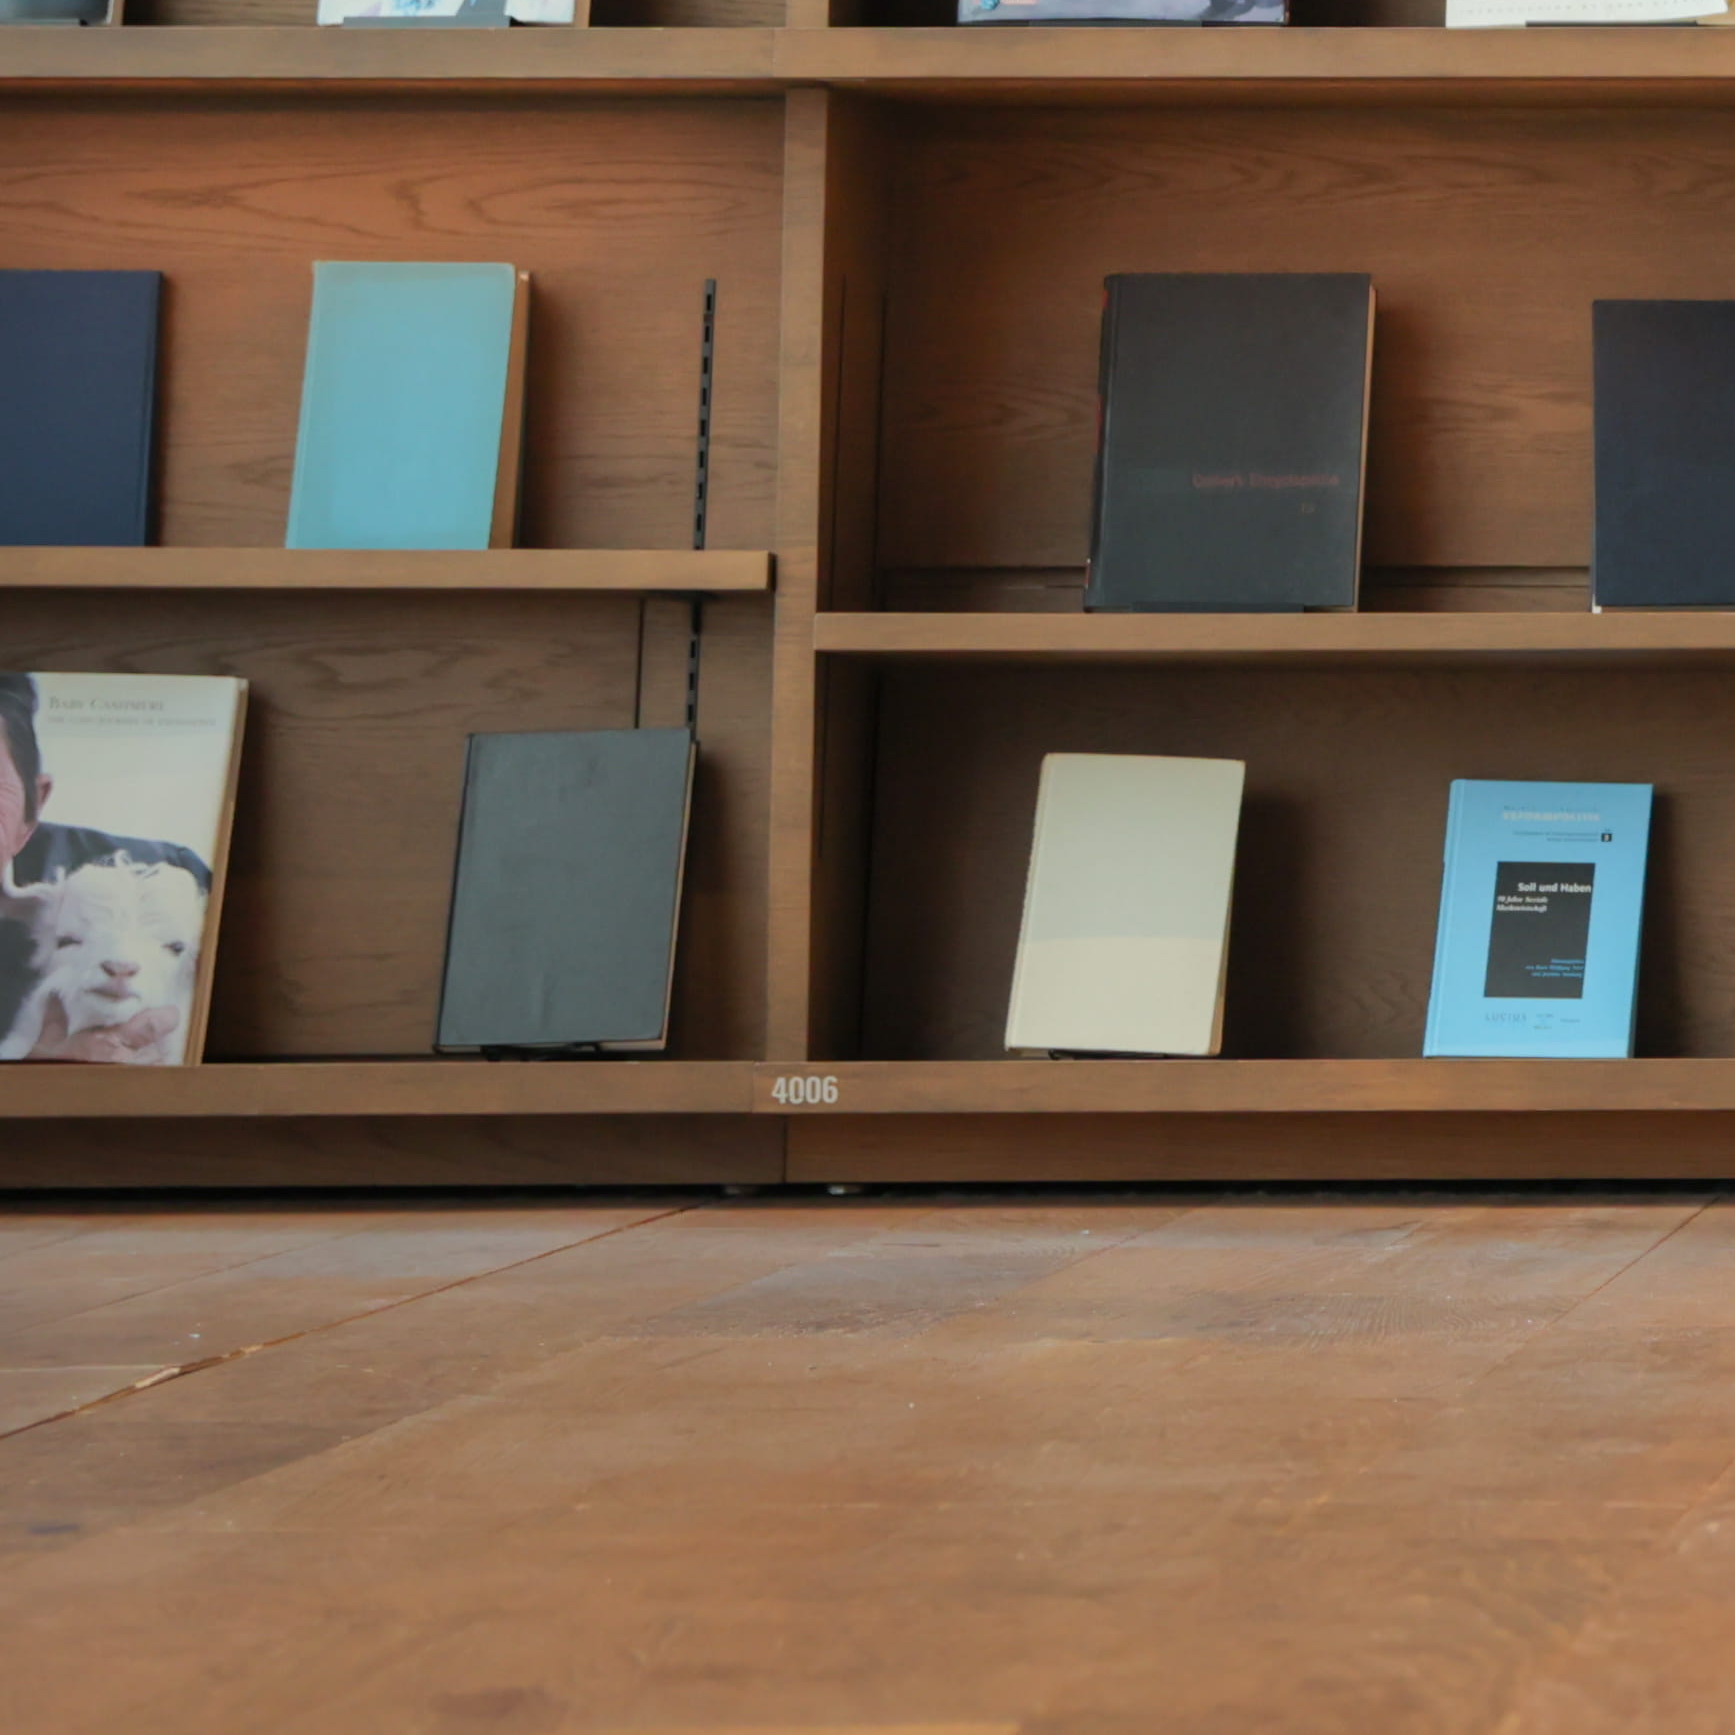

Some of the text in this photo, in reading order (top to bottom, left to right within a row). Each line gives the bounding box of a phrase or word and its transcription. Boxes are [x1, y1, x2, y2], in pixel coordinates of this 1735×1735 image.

[1518, 882, 1592, 893] Soll und Haben
[771, 1075, 839, 1104] 4006
